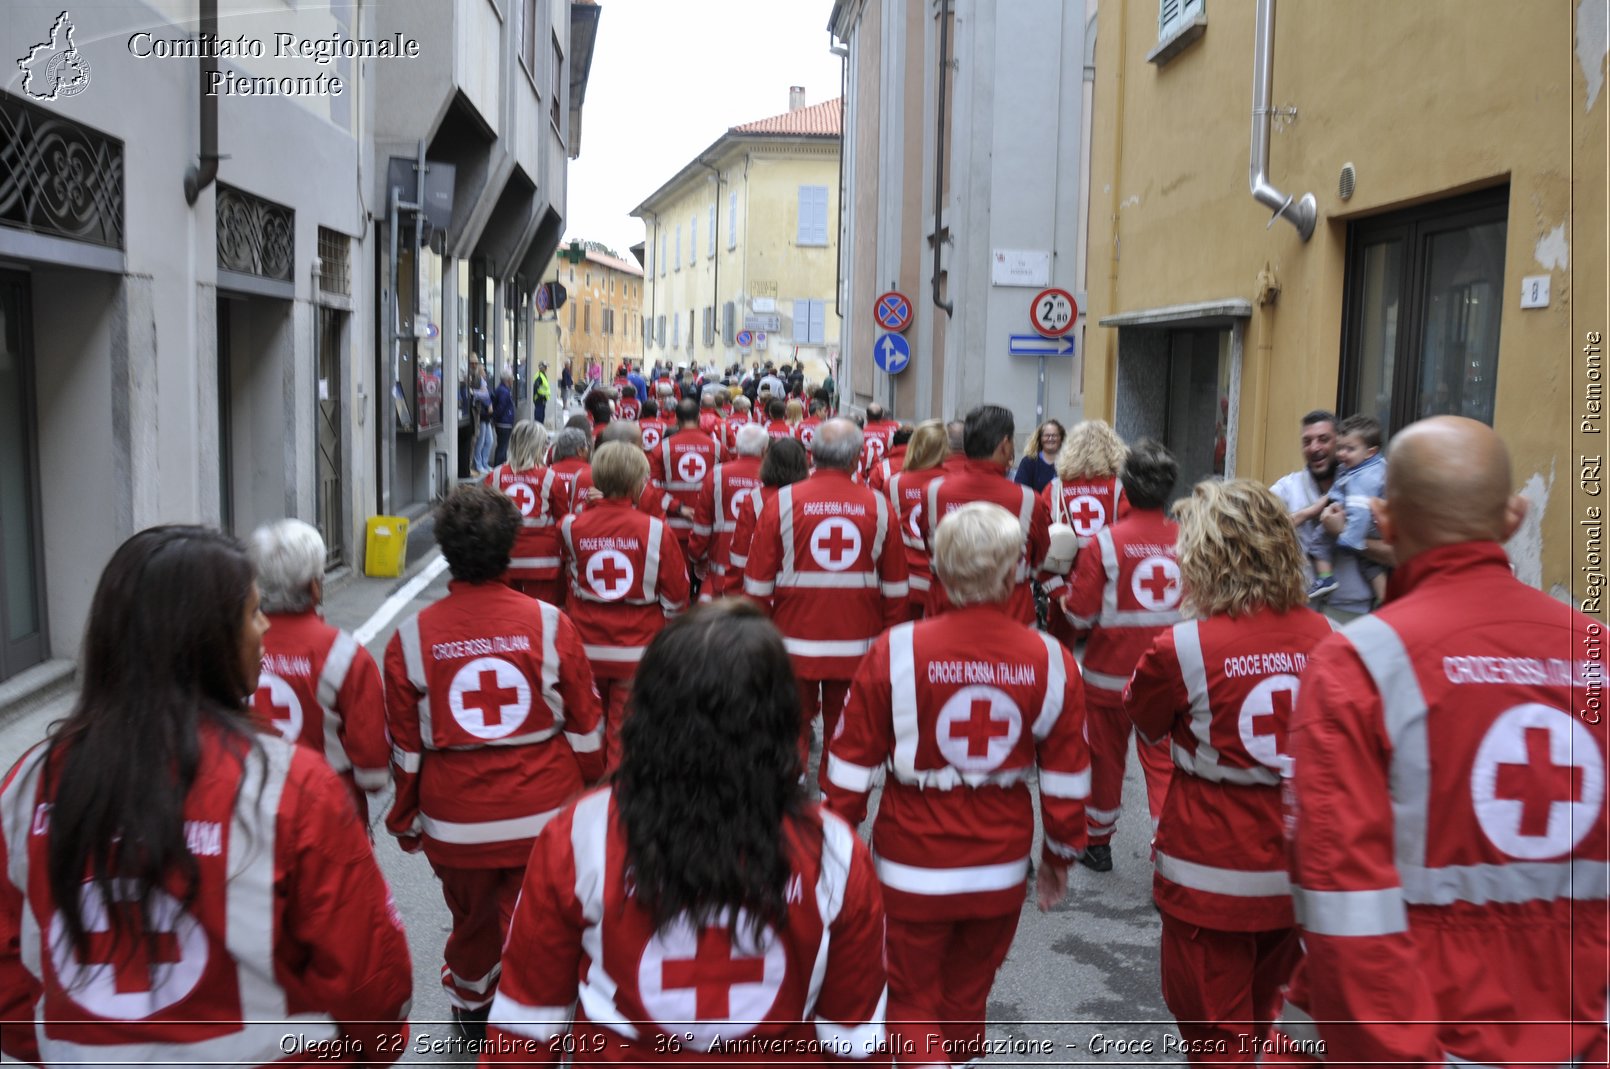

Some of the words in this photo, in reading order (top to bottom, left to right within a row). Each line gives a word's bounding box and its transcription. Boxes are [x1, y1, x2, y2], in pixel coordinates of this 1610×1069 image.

[432, 641, 465, 660] CROCE
[464, 638, 493, 656] ROSSA
[492, 635, 530, 653] ITALIANA
[928, 660, 963, 684] CROCE
[964, 661, 995, 684] ROSSA
[997, 661, 1036, 686] ITALIANA
[1224, 654, 1261, 678] CROCE
[1262, 652, 1294, 673] ROSSA
